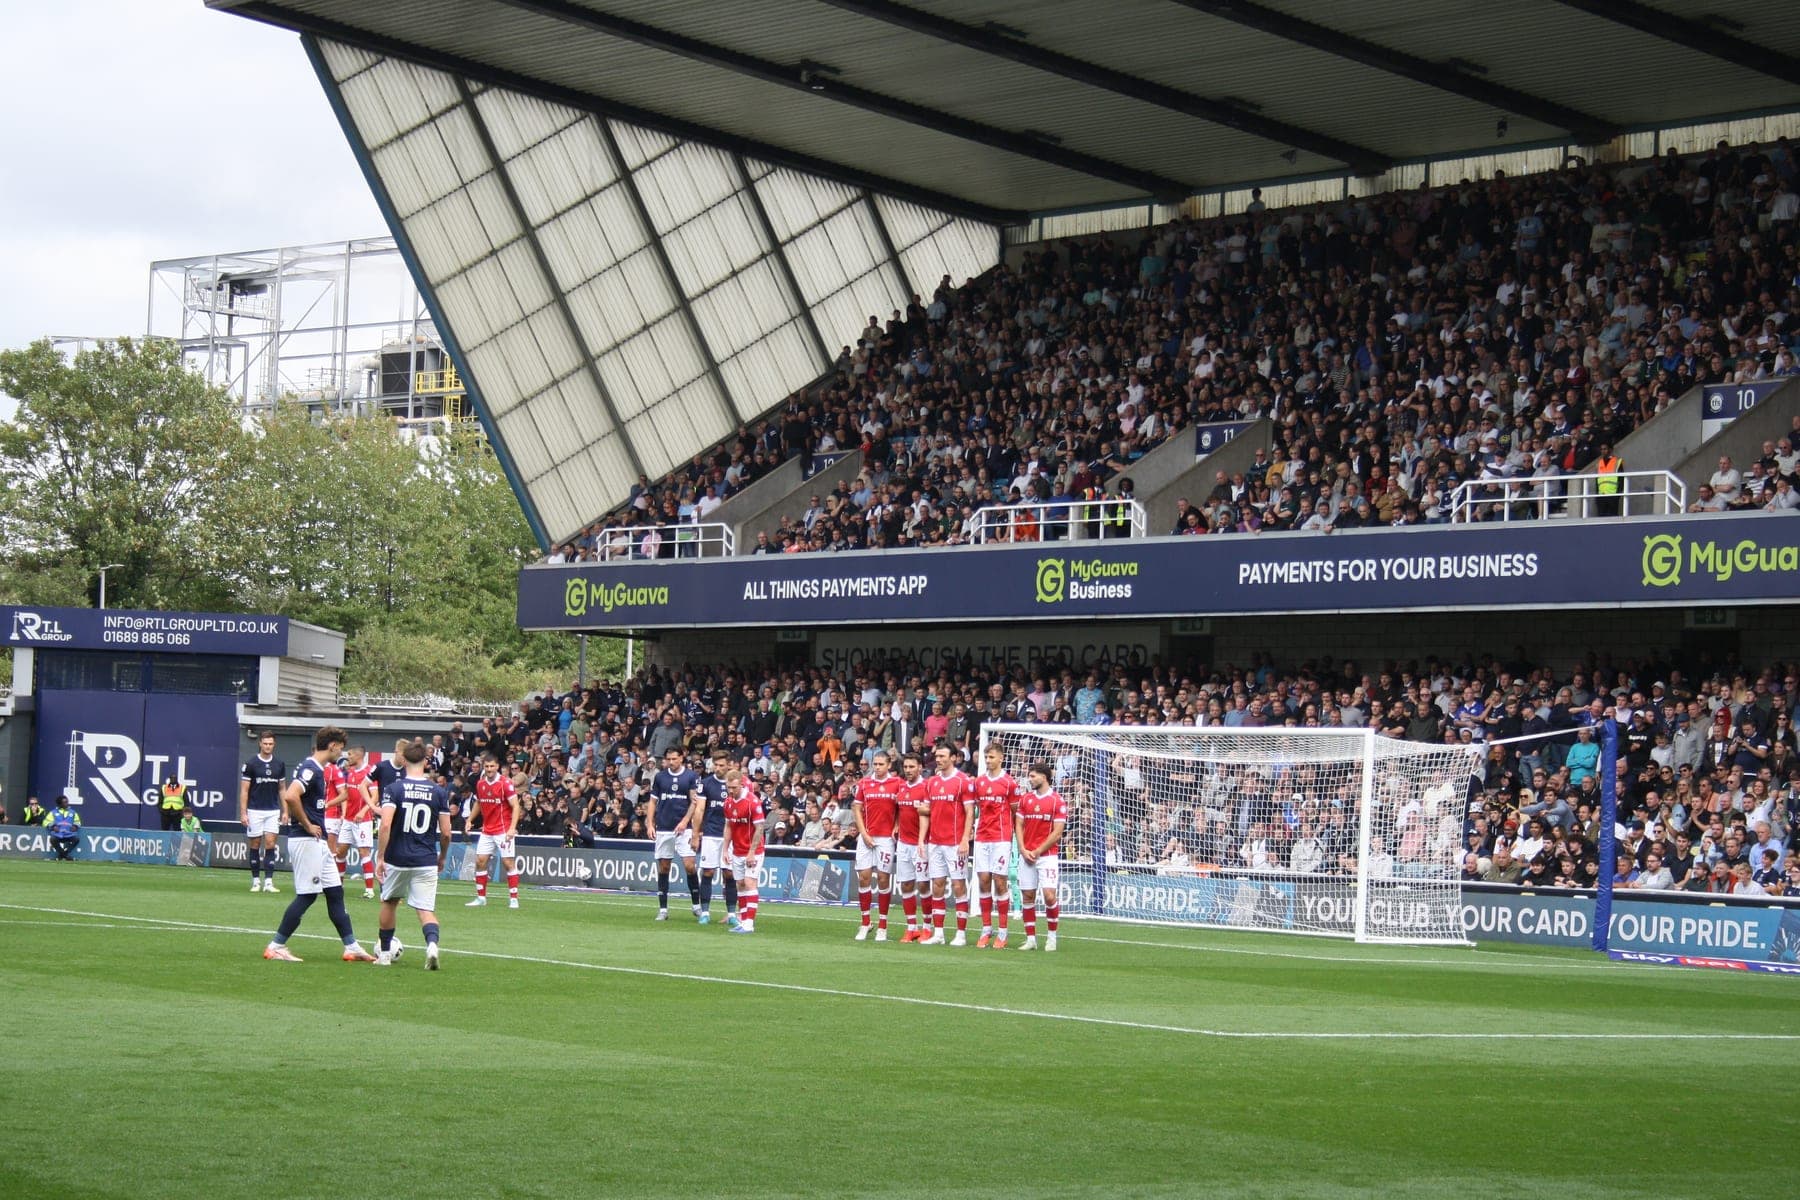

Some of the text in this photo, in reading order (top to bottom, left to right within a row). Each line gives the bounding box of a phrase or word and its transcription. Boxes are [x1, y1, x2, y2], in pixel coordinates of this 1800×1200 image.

[1736, 389, 1755, 410] 10
[1223, 428, 1234, 443] 11
[1070, 560, 1138, 582] MyGuava
[1238, 553, 1538, 584] PAYMENTS FOR YOUR BUSINESS
[743, 575, 927, 600] ALL THINGS PAYMENTS APP
[1069, 581, 1132, 599] Business
[591, 583, 669, 612] MyGuava
[103, 616, 279, 634] INFO@RTLGROUPLTD.CO.UK
[41, 633, 73, 641] GROUP
[103, 631, 190, 645] 01689 885 066
[143, 789, 223, 808] GUP
[402, 802, 432, 834] 10
[360, 831, 366, 840] 6
[215, 841, 247, 860] YOUR
[880, 851, 891, 864] 15
[516, 855, 545, 876] OUR
[594, 859, 635, 881] YOUR
[637, 861, 683, 884] CAD.
[916, 861, 928, 872] 37
[954, 860, 965, 870] 19
[998, 856, 1005, 866] 4
[1045, 868, 1056, 879] 13
[1446, 903, 1511, 933] YOUR
[1517, 908, 1594, 938] CARD.
[1680, 917, 1766, 949] PRIDE.
